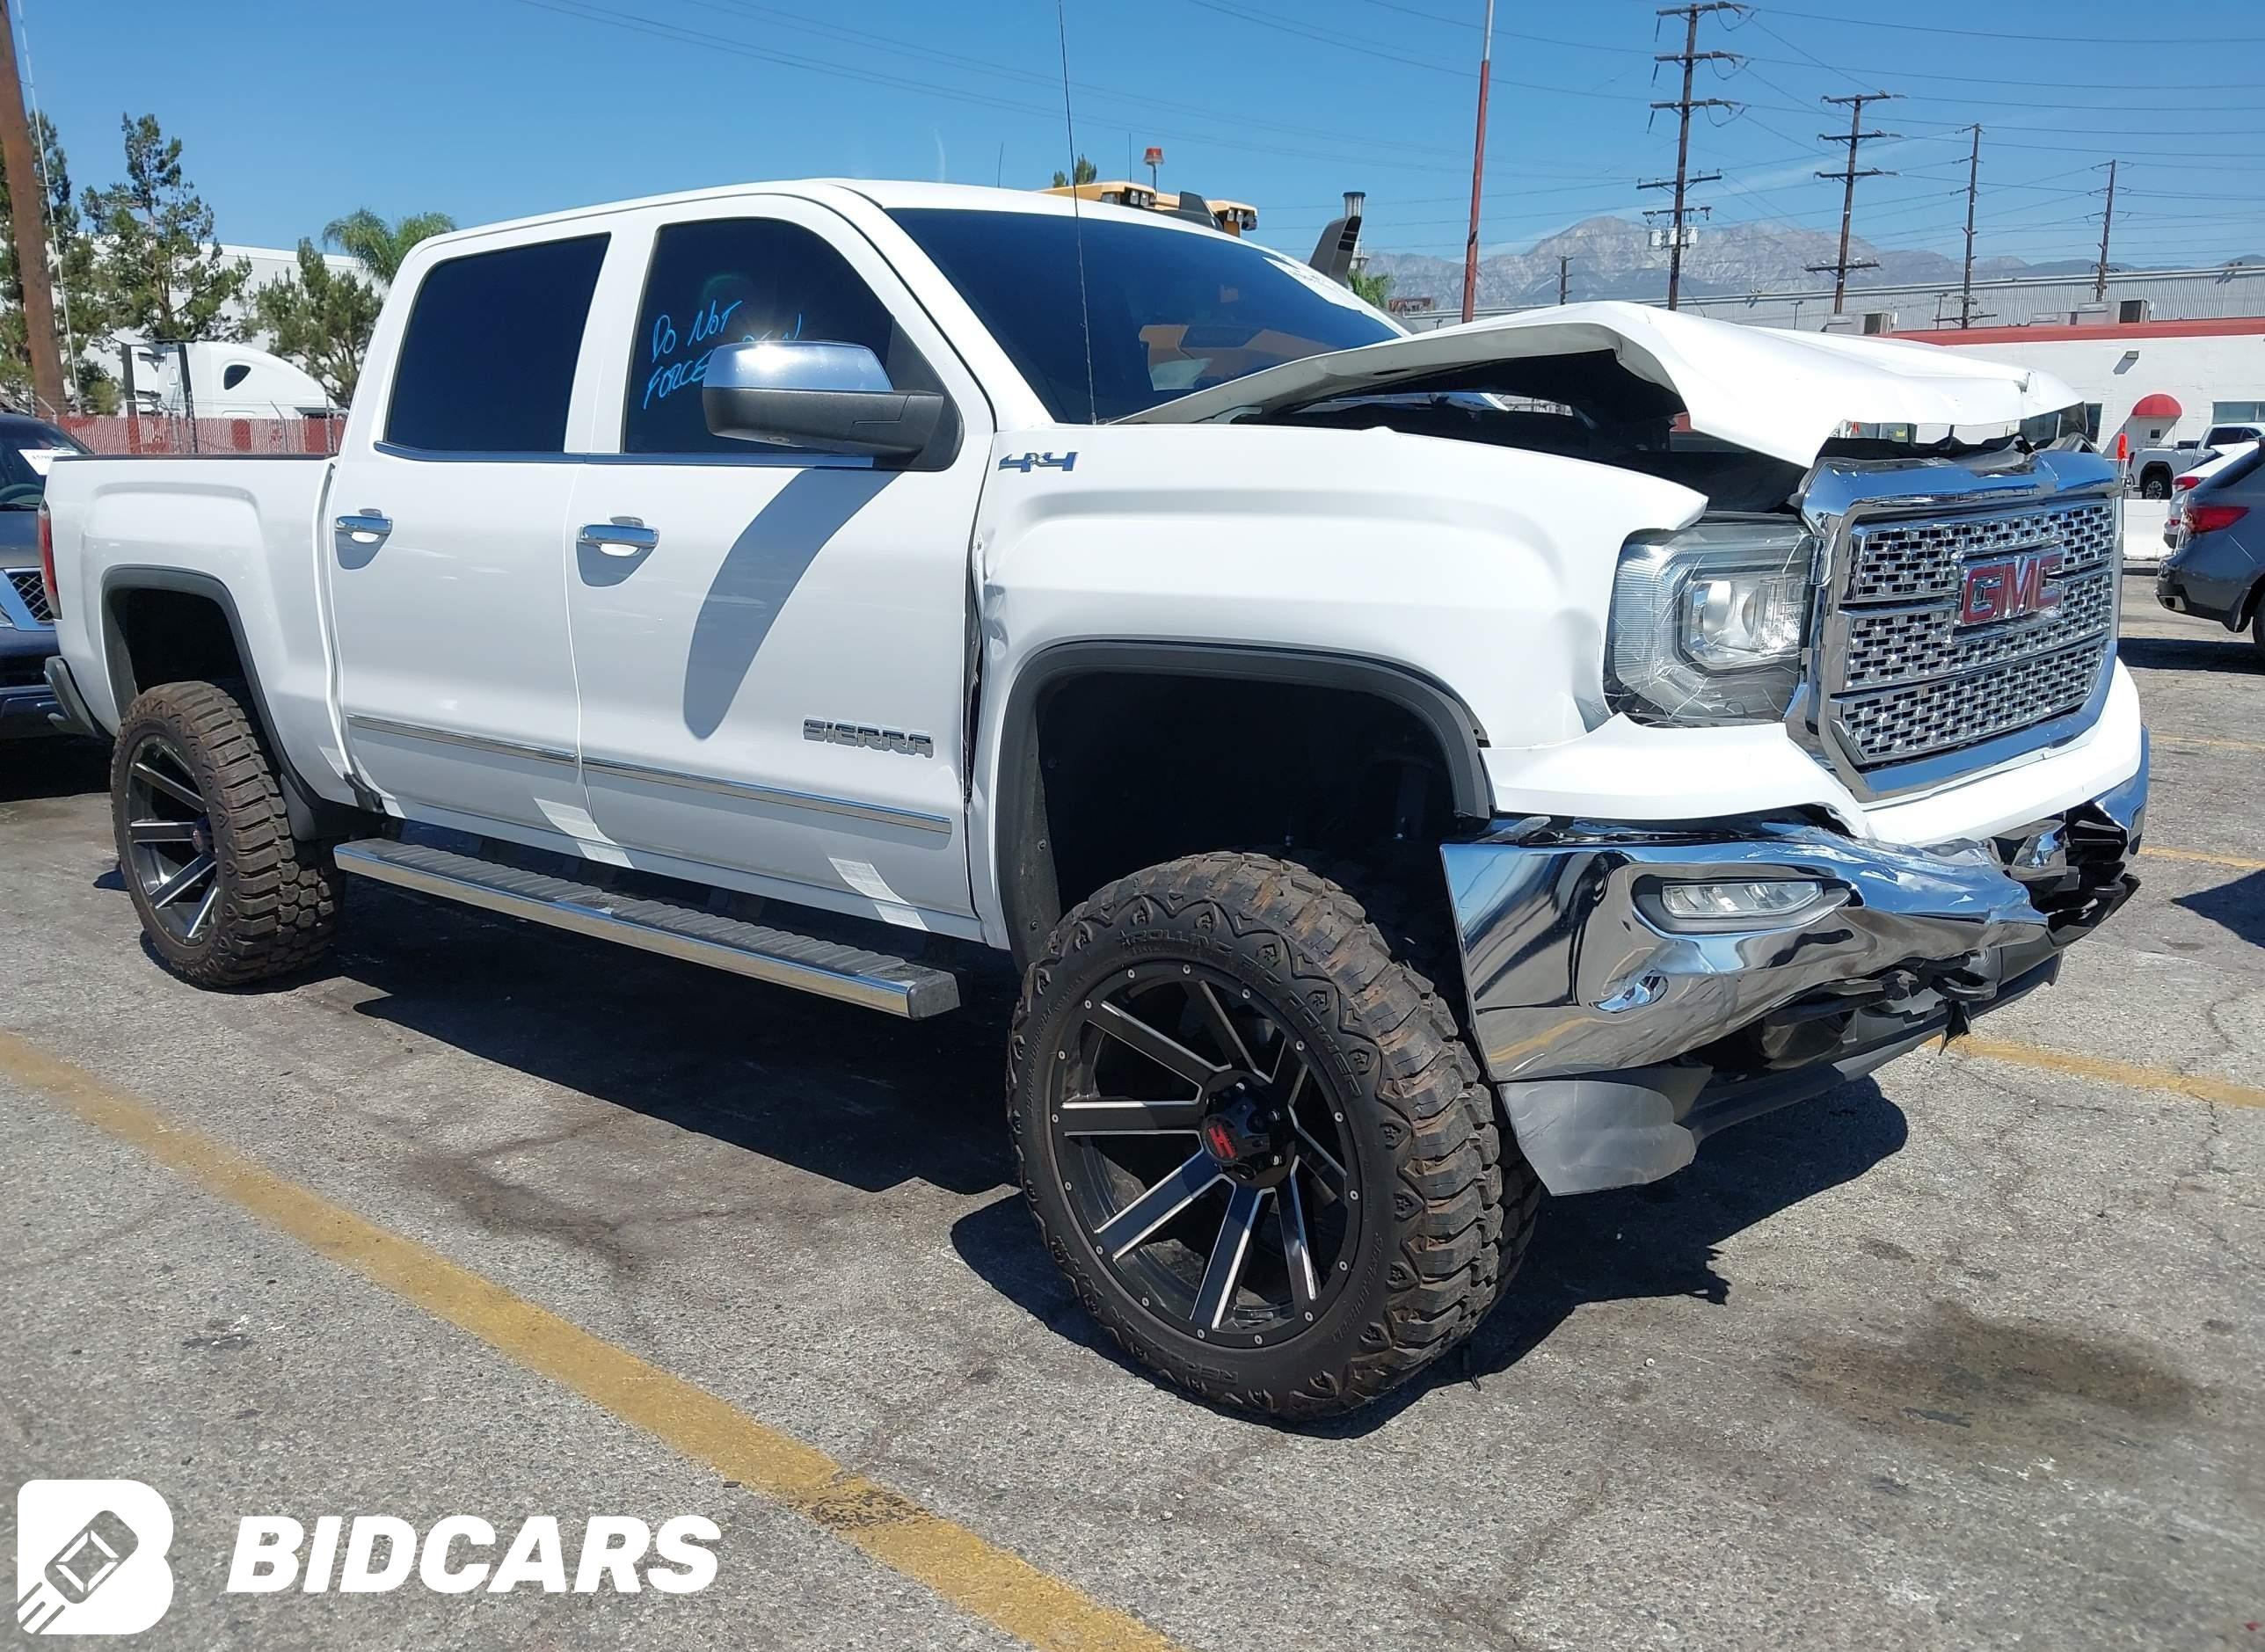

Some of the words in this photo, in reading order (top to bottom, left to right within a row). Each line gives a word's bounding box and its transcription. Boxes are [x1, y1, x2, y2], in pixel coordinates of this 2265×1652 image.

[644, 349, 713, 410] FORCE
[1963, 555, 2063, 624] GMC
[803, 718, 934, 758] SIERRA
